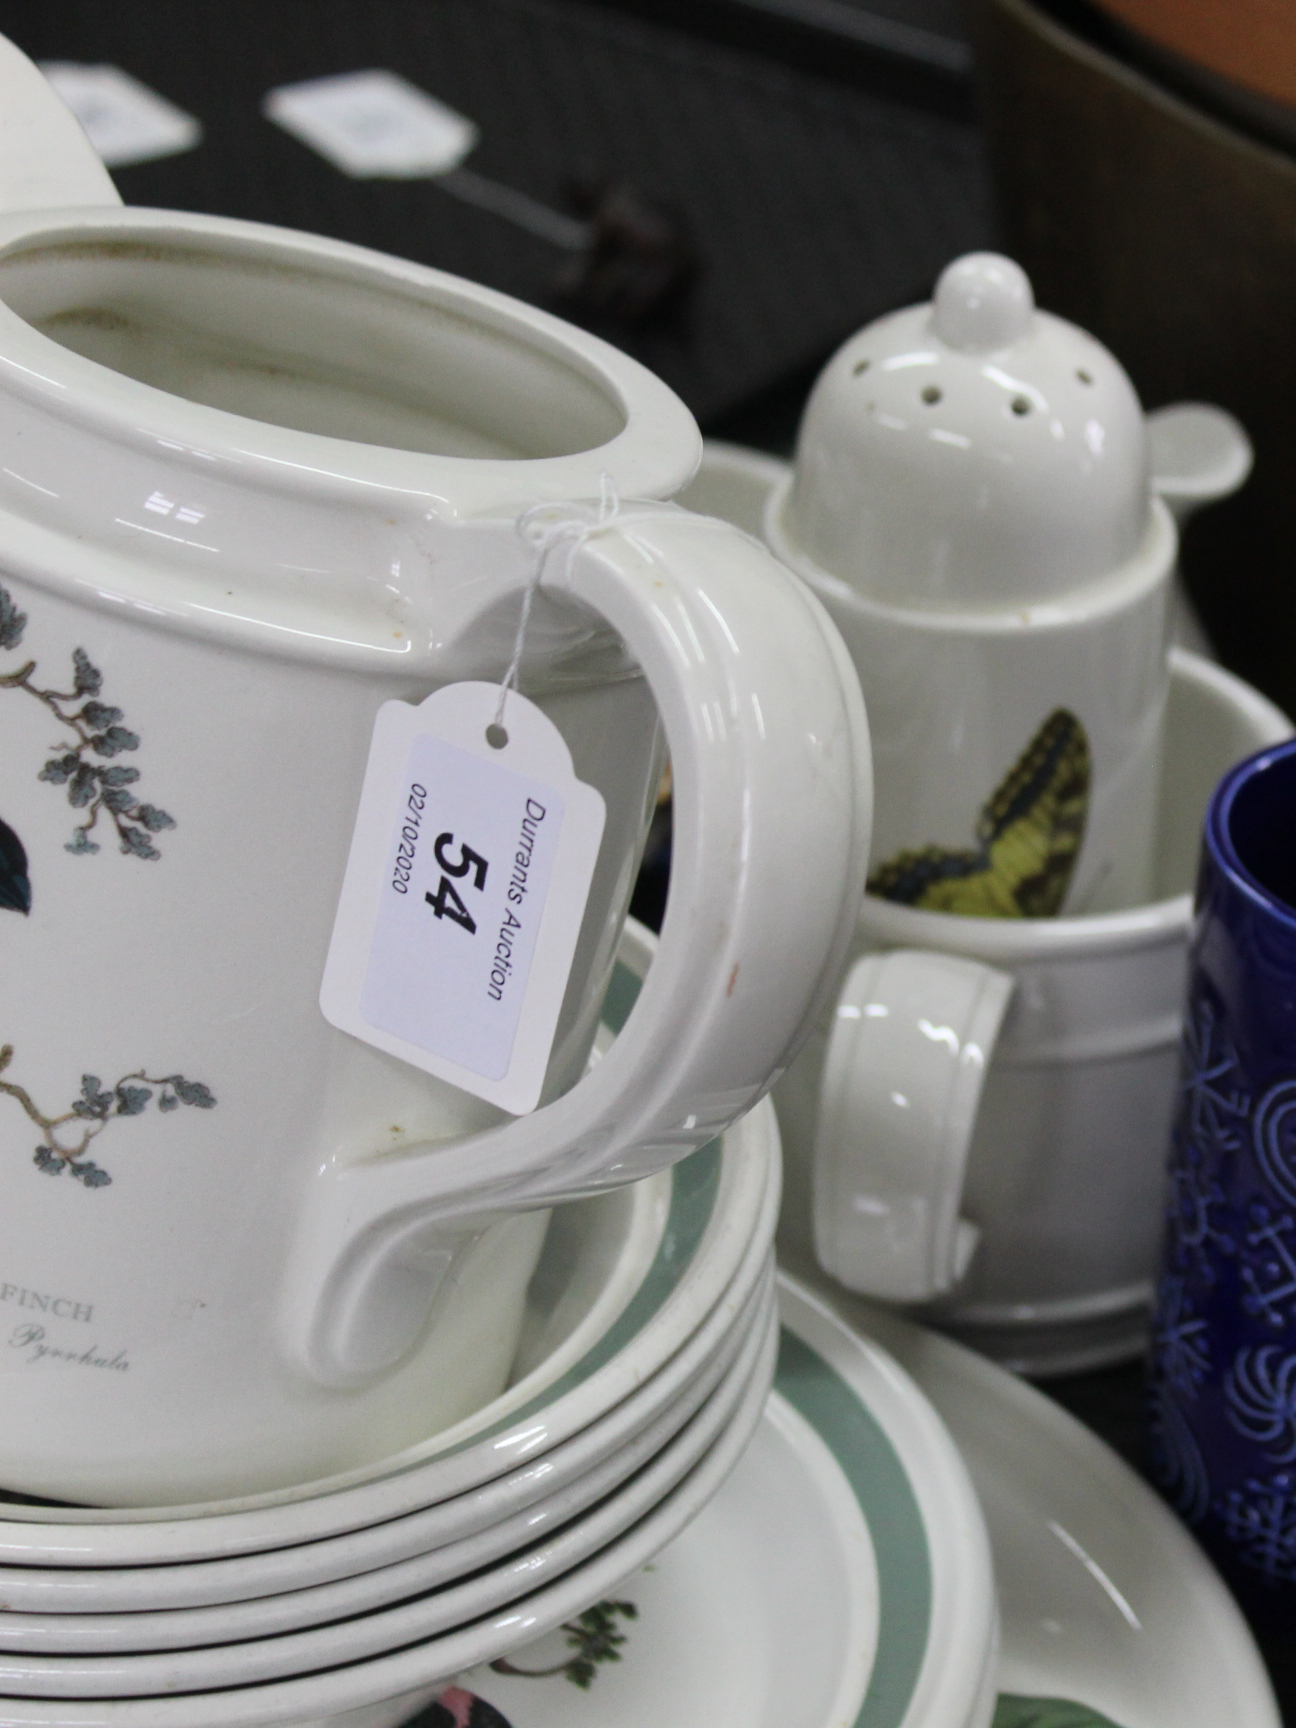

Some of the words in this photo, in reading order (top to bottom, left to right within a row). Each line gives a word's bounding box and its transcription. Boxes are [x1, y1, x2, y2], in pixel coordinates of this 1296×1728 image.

[392, 783, 427, 894] 02/10/2020
[425, 832, 489, 935] 54
[507, 798, 546, 905] Durrants
[487, 908, 522, 1001] Auction
